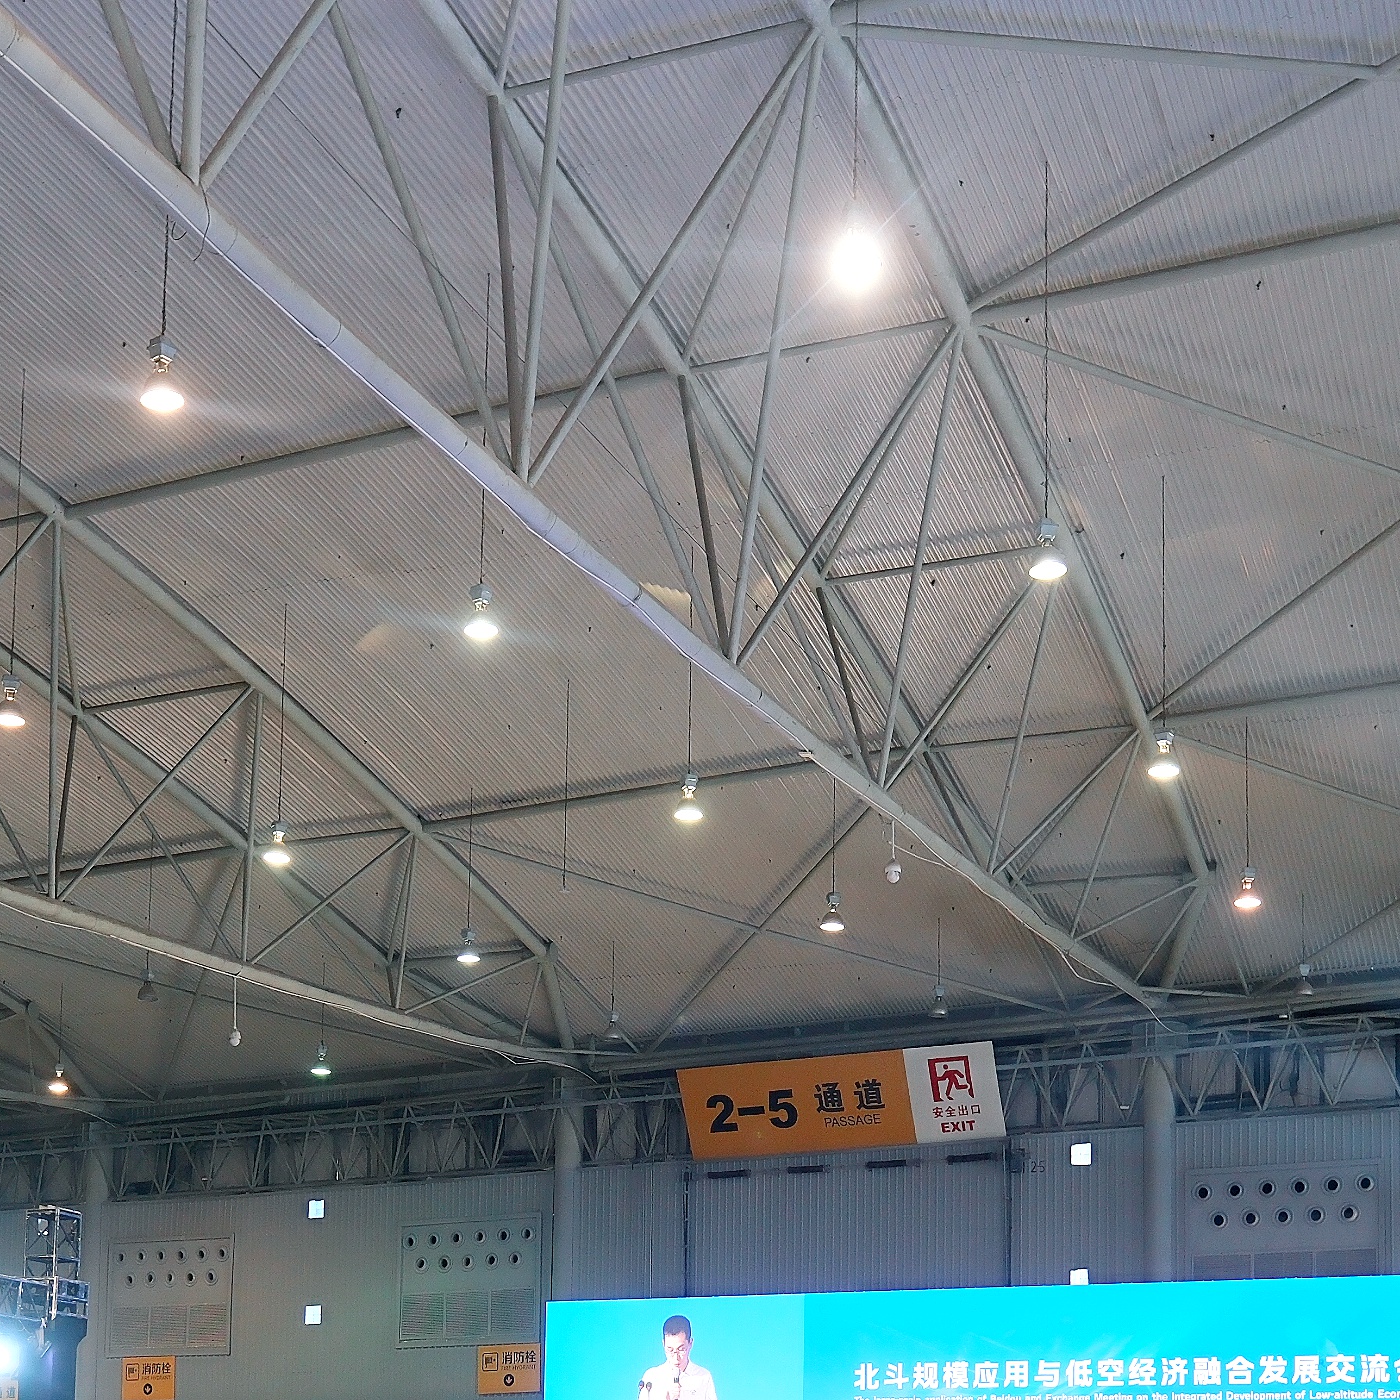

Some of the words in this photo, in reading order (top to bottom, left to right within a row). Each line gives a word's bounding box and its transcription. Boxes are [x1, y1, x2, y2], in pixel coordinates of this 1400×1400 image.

[813, 1079, 886, 1114] 通道
[706, 1089, 798, 1134] 2-5
[932, 1104, 981, 1119] 安全出口
[823, 1113, 882, 1128] PASSAGE
[941, 1119, 976, 1133] EXIT
[501, 1350, 537, 1364] 消防栓
[141, 1362, 172, 1376] 消防栓
[1152, 1392, 1168, 1400] the
[1294, 1390, 1306, 1399] of
[1309, 1390, 1374, 1399] Low-altitude
